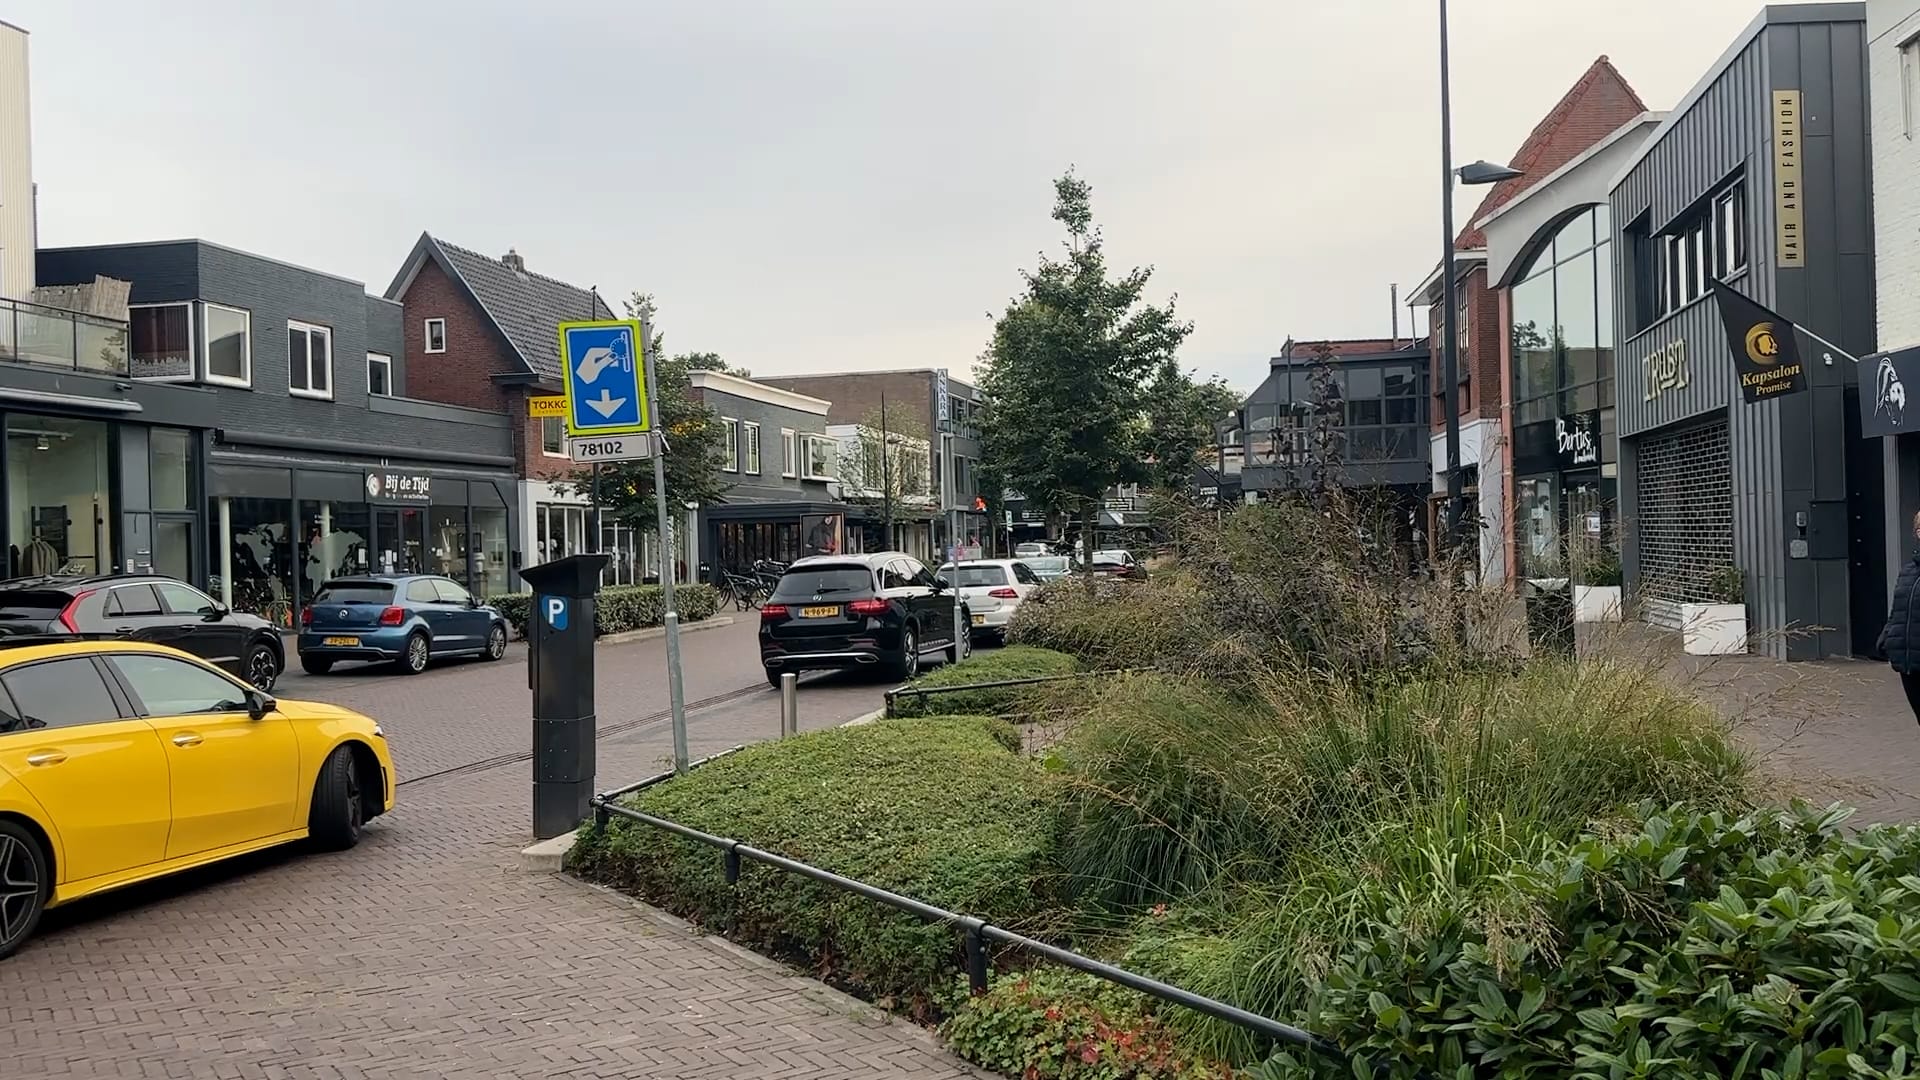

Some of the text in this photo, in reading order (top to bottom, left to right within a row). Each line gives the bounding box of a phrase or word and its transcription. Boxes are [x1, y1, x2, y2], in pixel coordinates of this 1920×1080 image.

[1780, 99, 1797, 260] HAIR AND FASHION
[1742, 364, 1800, 386] Kapsalon
[1756, 381, 1792, 396] Promise
[579, 441, 623, 456] 78102
[385, 474, 430, 494] Bij de Tijd
[548, 599, 564, 624] P
